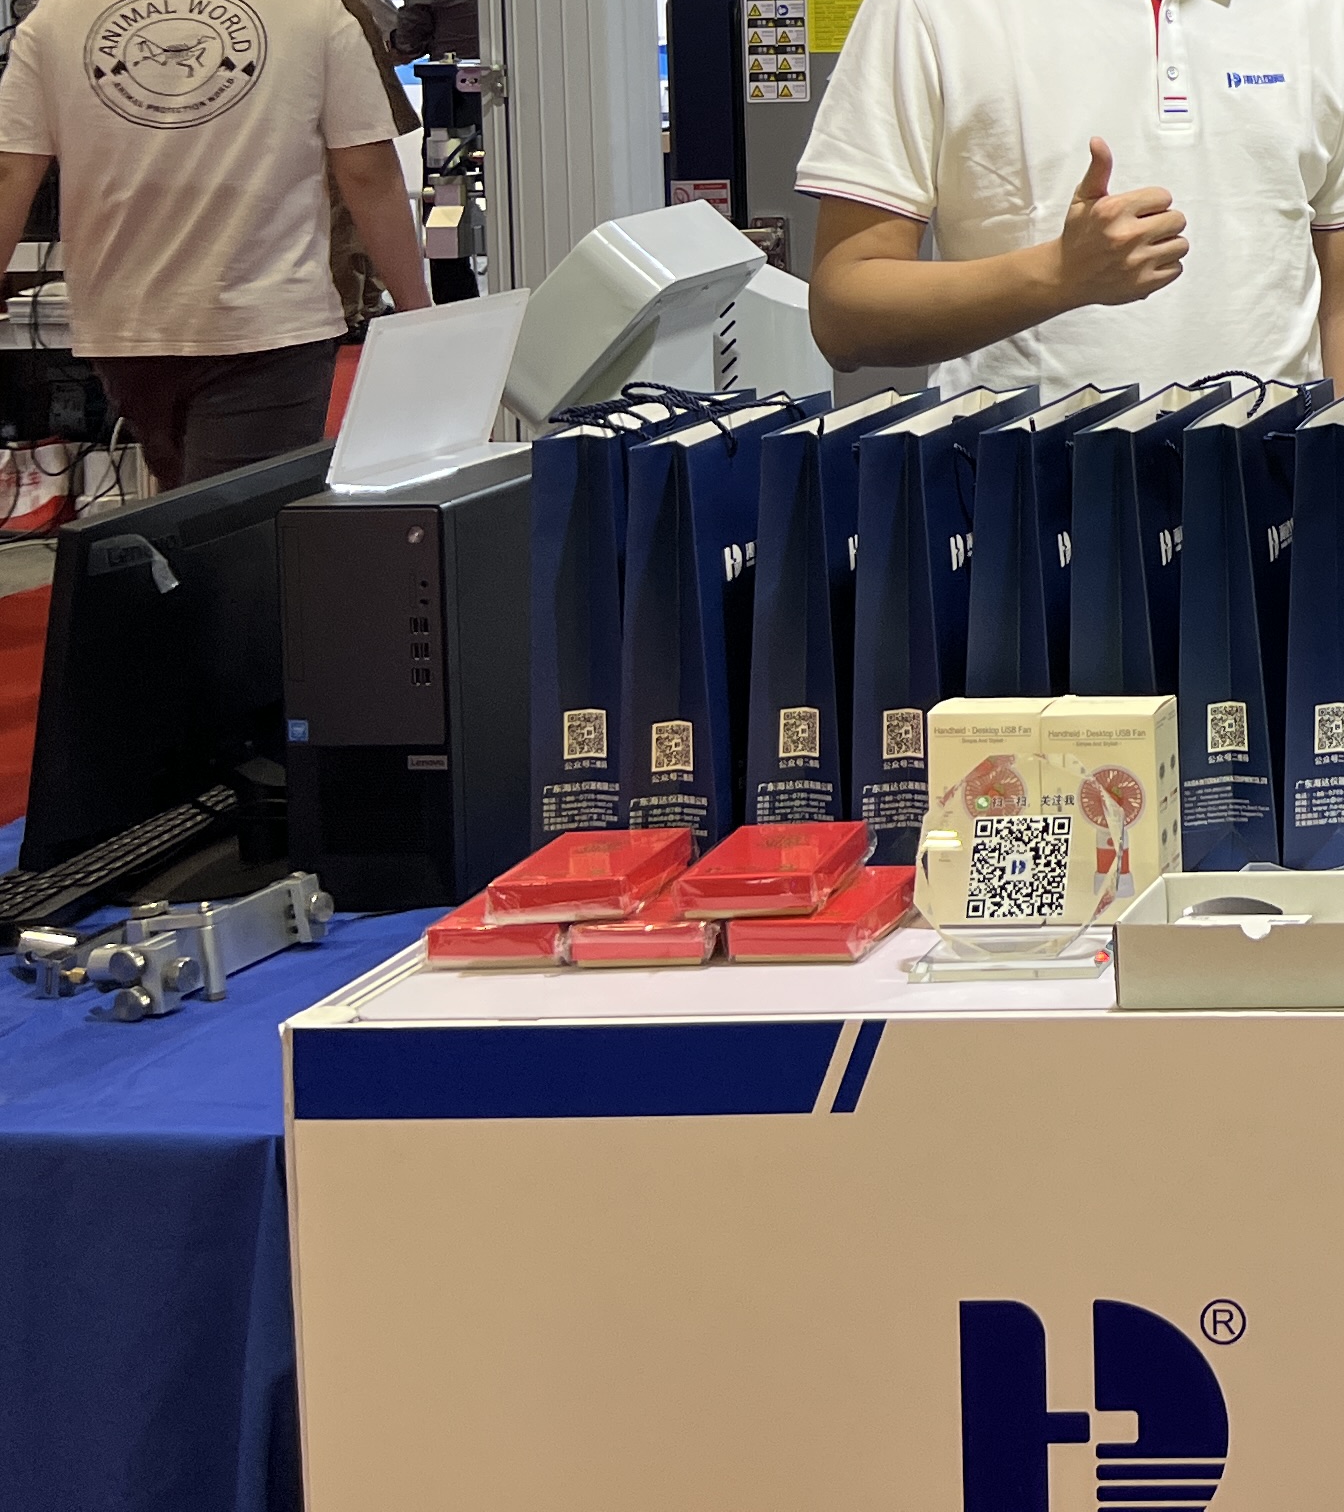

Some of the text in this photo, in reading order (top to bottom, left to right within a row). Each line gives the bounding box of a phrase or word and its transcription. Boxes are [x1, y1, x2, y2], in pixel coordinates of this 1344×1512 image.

[98, 0, 178, 59] ANIMAL
[1018, 725, 1032, 735] Fan
[1115, 728, 1131, 738] USB
[1132, 728, 1146, 738] Fan
